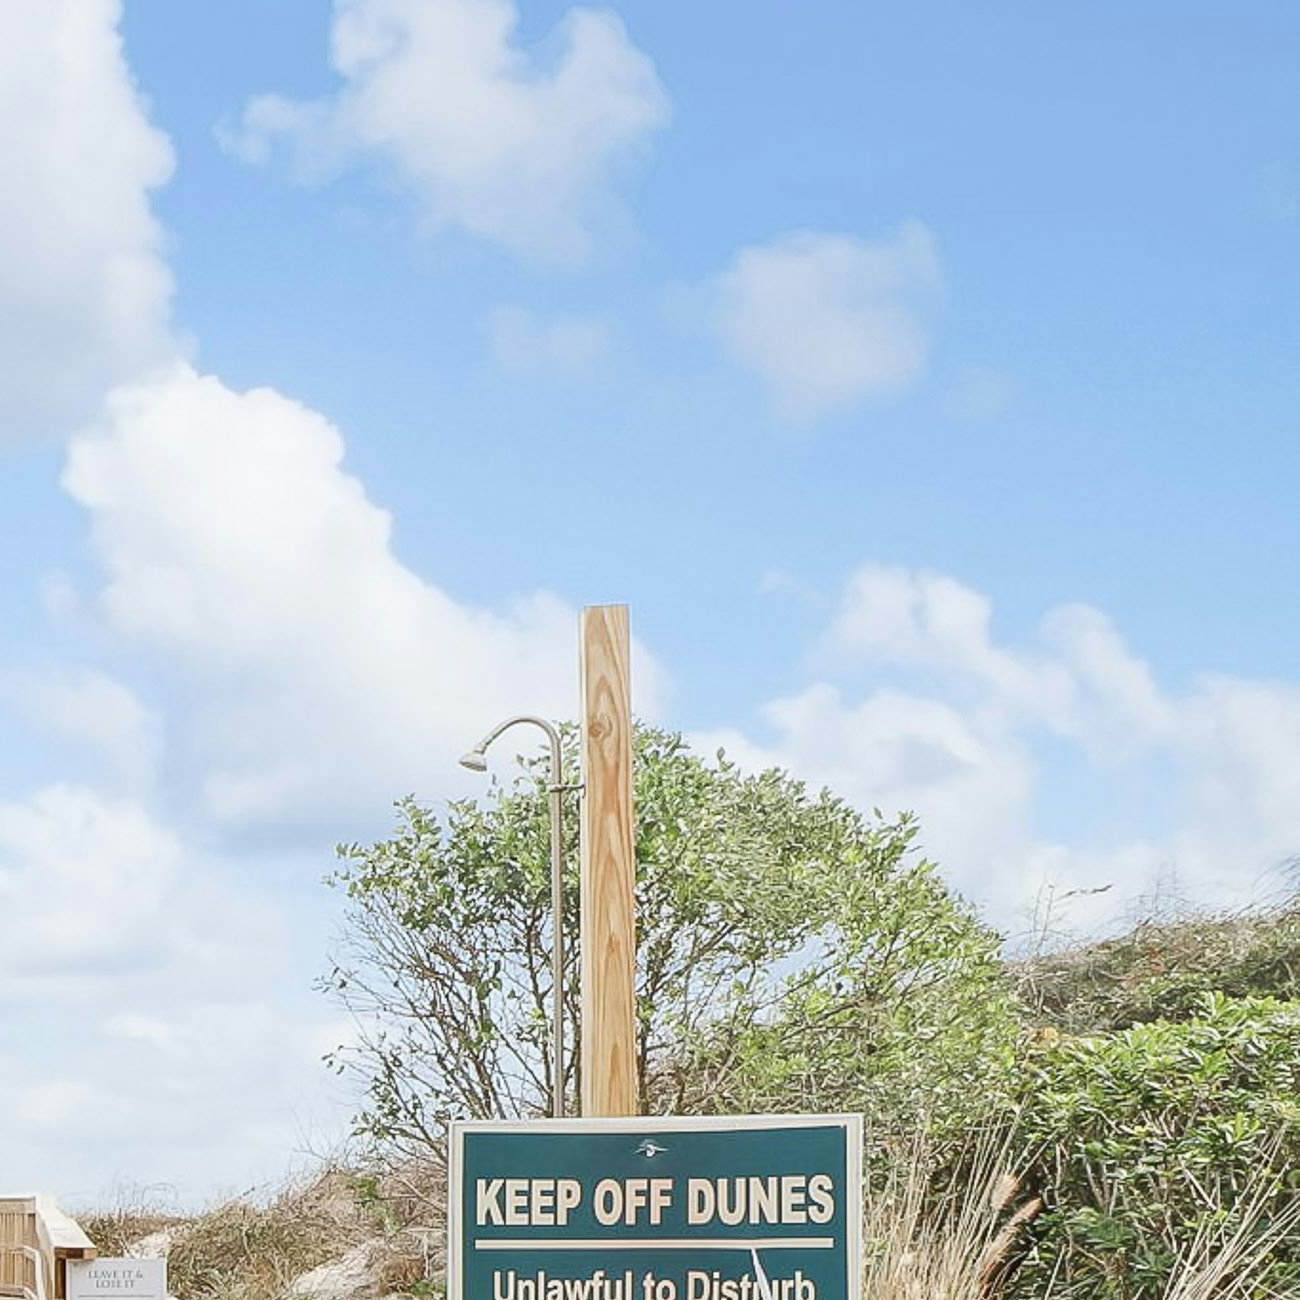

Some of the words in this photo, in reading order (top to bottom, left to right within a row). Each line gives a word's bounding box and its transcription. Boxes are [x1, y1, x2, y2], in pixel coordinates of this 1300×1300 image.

[475, 1177, 582, 1226] KEEP
[593, 1177, 674, 1226] OFF
[687, 1174, 835, 1226] DUNES
